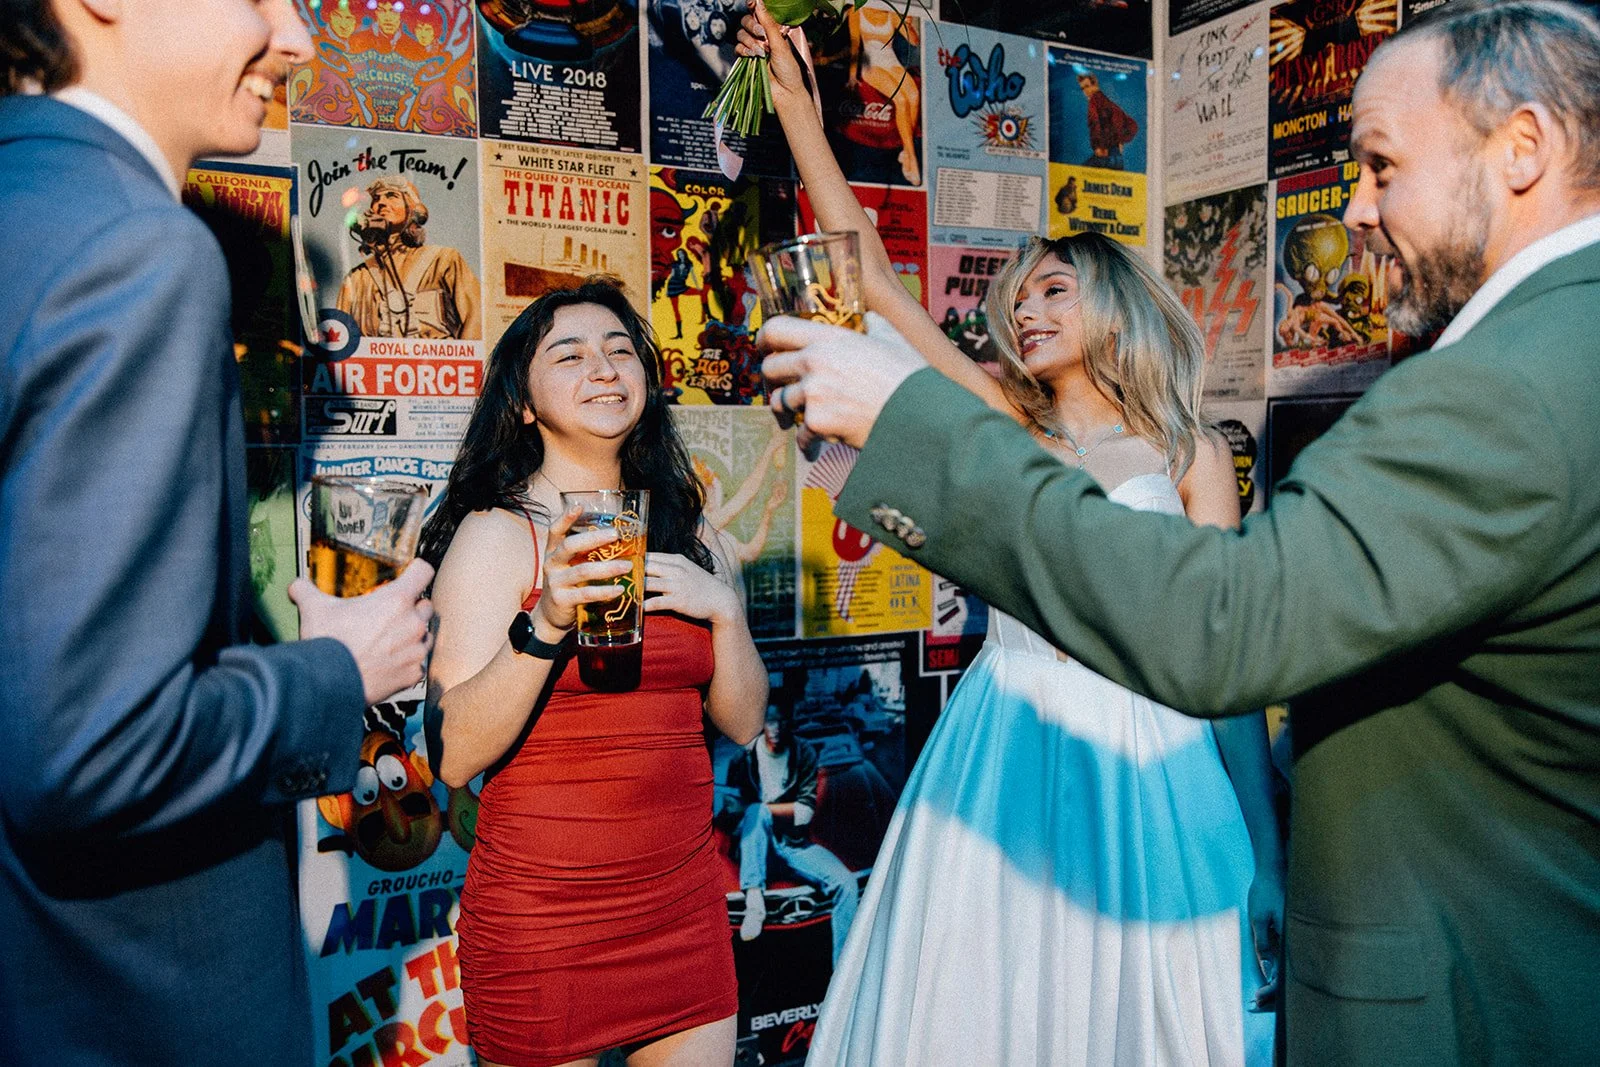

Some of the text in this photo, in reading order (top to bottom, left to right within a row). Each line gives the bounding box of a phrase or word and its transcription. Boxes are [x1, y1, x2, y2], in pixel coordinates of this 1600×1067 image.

[937, 47, 961, 67] the
[511, 60, 607, 88] LIVE 2018
[945, 43, 1026, 118] Who
[1195, 93, 1236, 124] WALL
[1273, 110, 1327, 140] MONCTON
[517, 145, 539, 153] SAILING
[518, 155, 615, 176] WHITE STAR FLEET
[196, 174, 272, 189] CALIFORNIA
[308, 159, 352, 218] Join
[352, 147, 388, 173] the
[504, 170, 630, 190] THE QUEEN OF THE OCEAN
[685, 184, 725, 196] COLOR
[504, 180, 630, 226] TITANIC
[1277, 182, 1358, 219] SAUCER-
[520, 220, 552, 230] WORLD'S
[554, 223, 583, 232] LARGEST
[584, 226, 608, 234] OCEAN
[945, 276, 990, 296] PUR
[370, 342, 475, 357] ROYAL CANADIAN
[312, 362, 476, 395] AIR FORCE
[315, 457, 452, 478] WINTER DANCE PART
[368, 870, 453, 896] GROUCHO
[320, 885, 464, 958] MAR
[328, 940, 460, 1056] AT TH
[751, 1003, 821, 1031] BEVERLY
[328, 1000, 472, 1067] RCU
